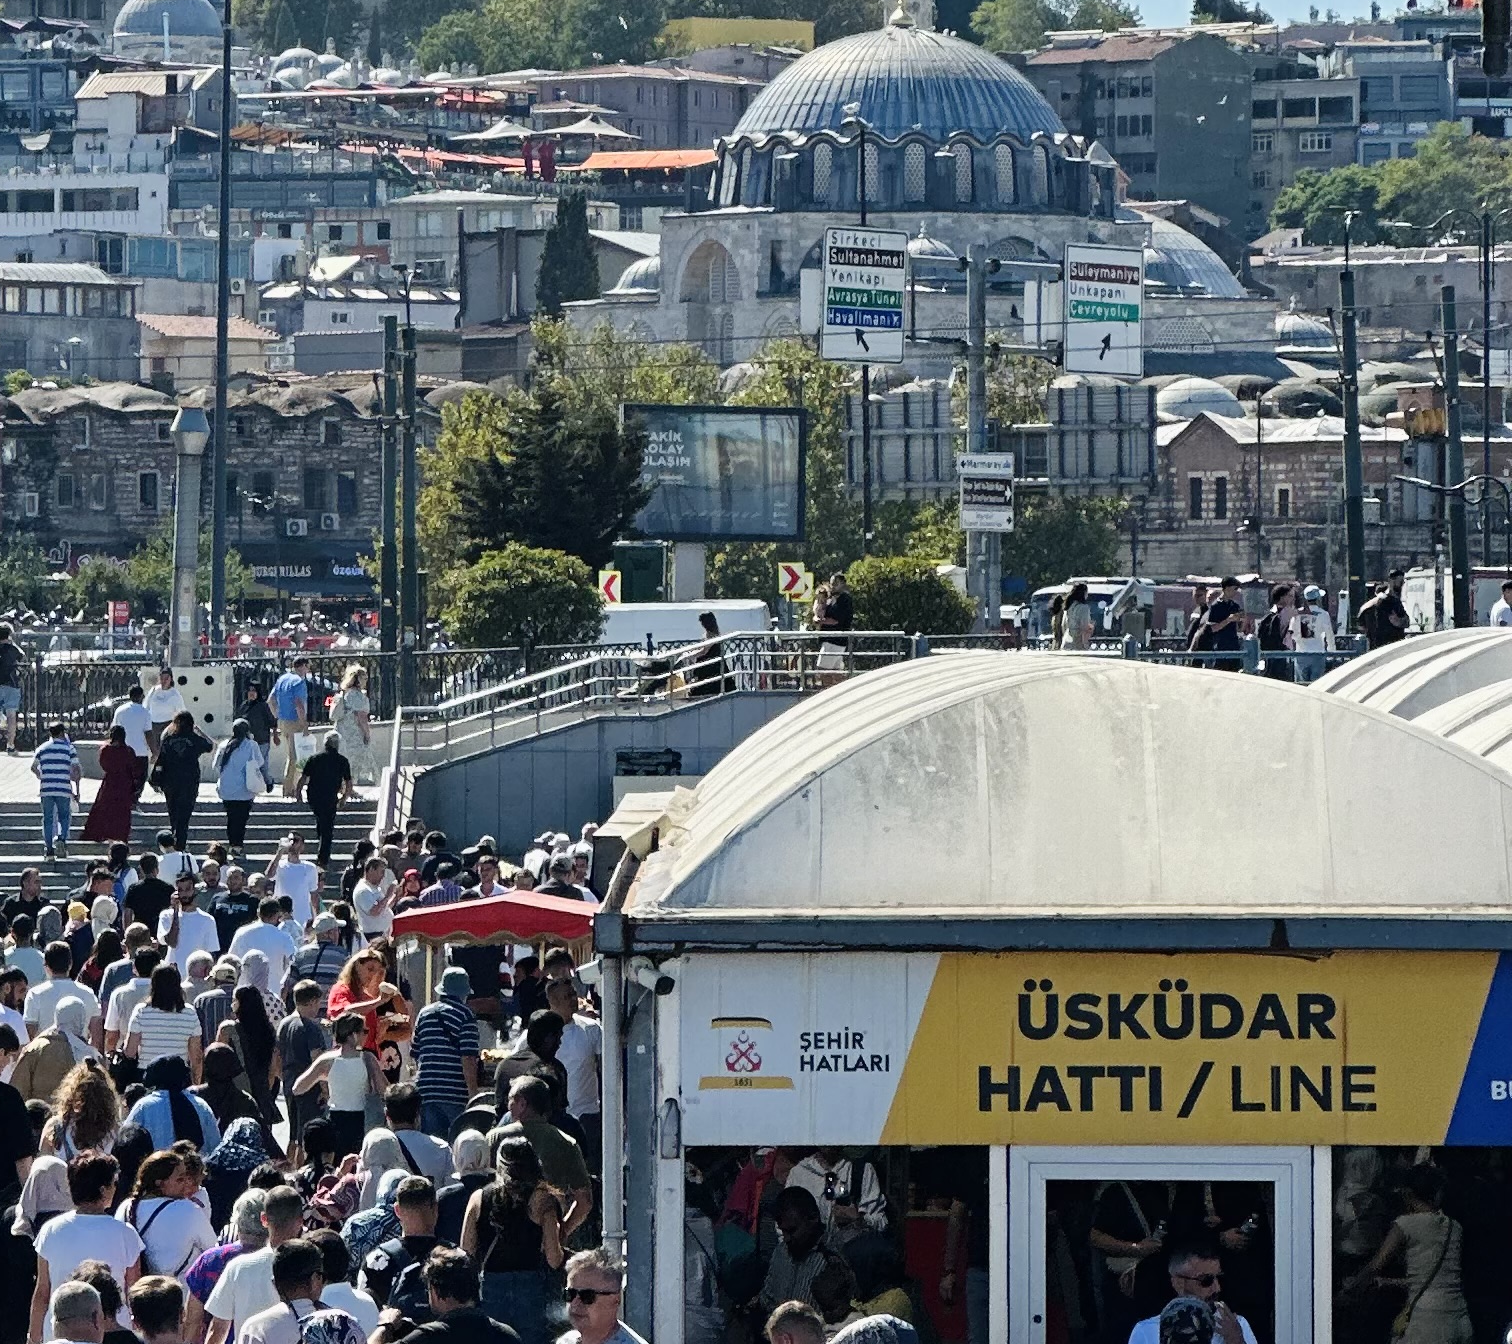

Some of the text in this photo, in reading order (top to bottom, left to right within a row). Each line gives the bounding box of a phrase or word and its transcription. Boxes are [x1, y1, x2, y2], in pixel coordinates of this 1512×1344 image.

[831, 231, 882, 248] Sirkeci
[830, 248, 904, 267] Sultanahmet
[830, 268, 885, 285] Yenikapı
[1070, 262, 1139, 283] Süleymaniye
[827, 288, 902, 306] Avrasya Tüneli
[1070, 282, 1127, 301] Unkapanı
[827, 308, 891, 327] Havalimanı
[1070, 301, 1129, 320] Çevreyolu
[643, 444, 685, 455] OLAY
[1018, 979, 1337, 1041] ÜSKÜDAR
[799, 1026, 865, 1053] ŞEHİR
[799, 1054, 890, 1073] HATLARI
[978, 1066, 1162, 1112] HATTI
[1231, 1066, 1377, 1112] LINE
